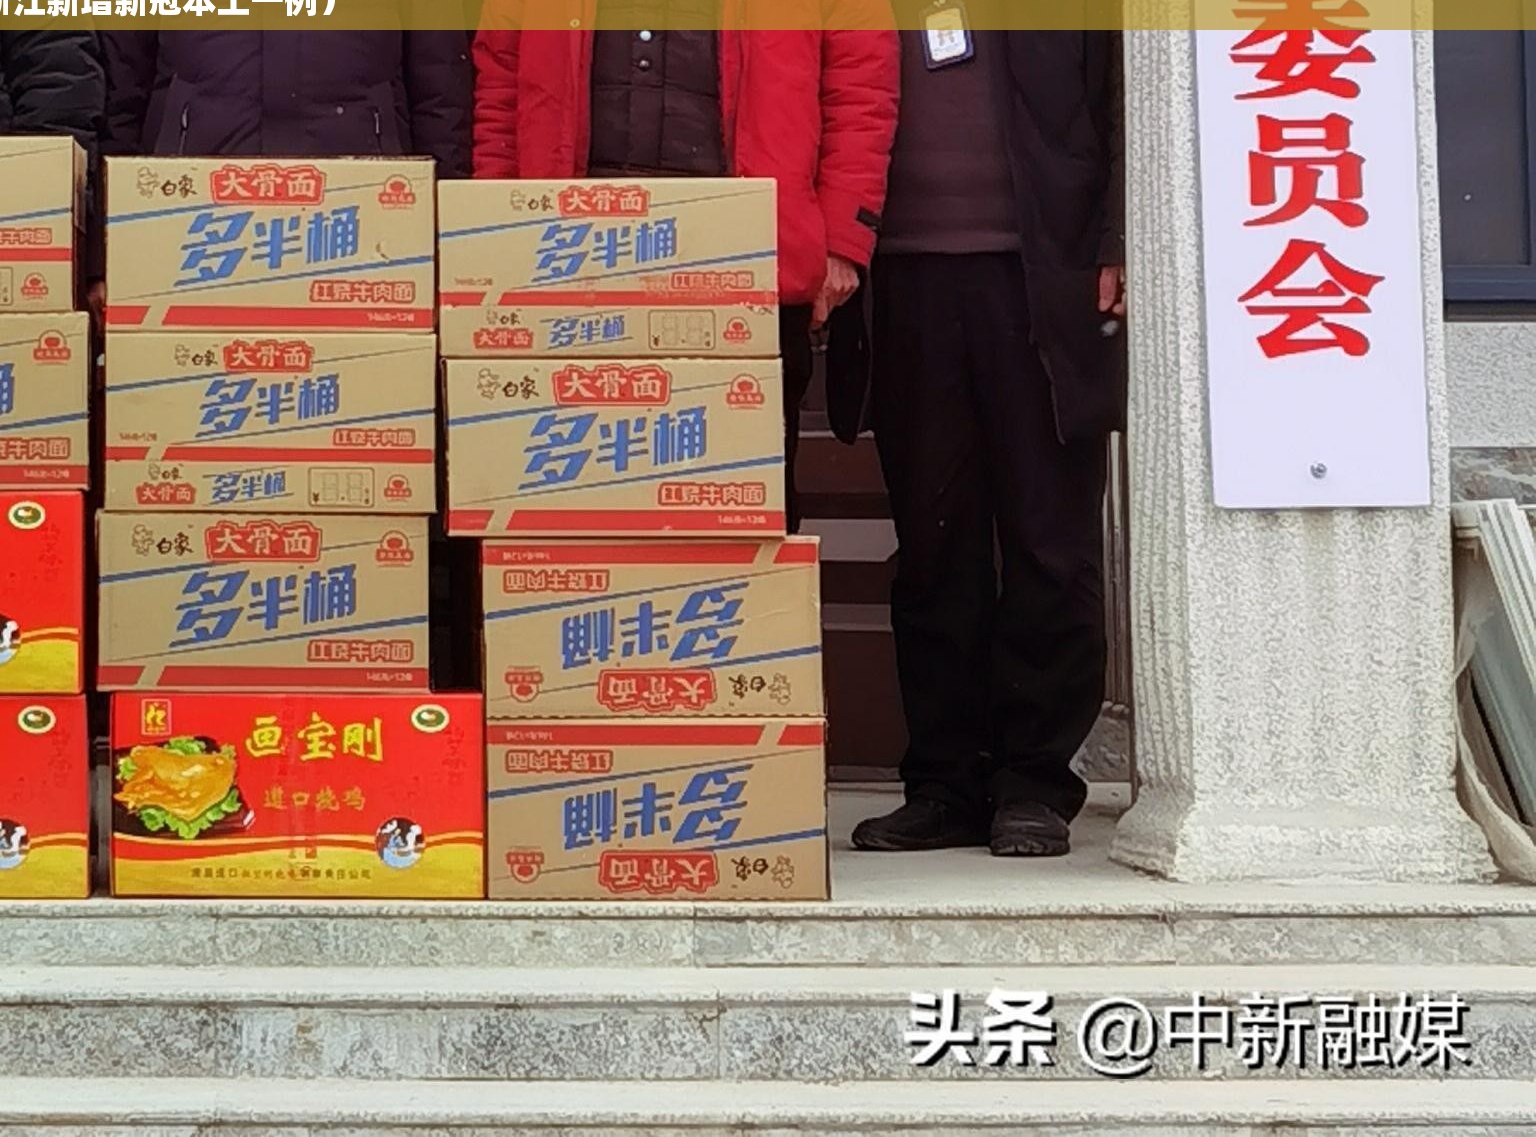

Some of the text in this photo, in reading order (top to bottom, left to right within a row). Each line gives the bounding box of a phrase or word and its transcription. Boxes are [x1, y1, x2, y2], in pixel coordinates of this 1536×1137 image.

[220, 170, 317, 198] 大骨面
[566, 189, 643, 212] 大骨面
[174, 206, 360, 287] 多半桶
[531, 217, 678, 283] 多半桶
[232, 345, 309, 368] 大骨面
[196, 374, 340, 438] 多半桶
[563, 370, 662, 399] 大骨面
[518, 406, 707, 490] 多半桶
[216, 526, 313, 555] 大骨面
[169, 563, 357, 647] 多半桶
[561, 582, 750, 670] 多半桶
[607, 674, 709, 704] 大骨面
[563, 764, 754, 850] 多半桶
[610, 856, 709, 886] 大骨面
